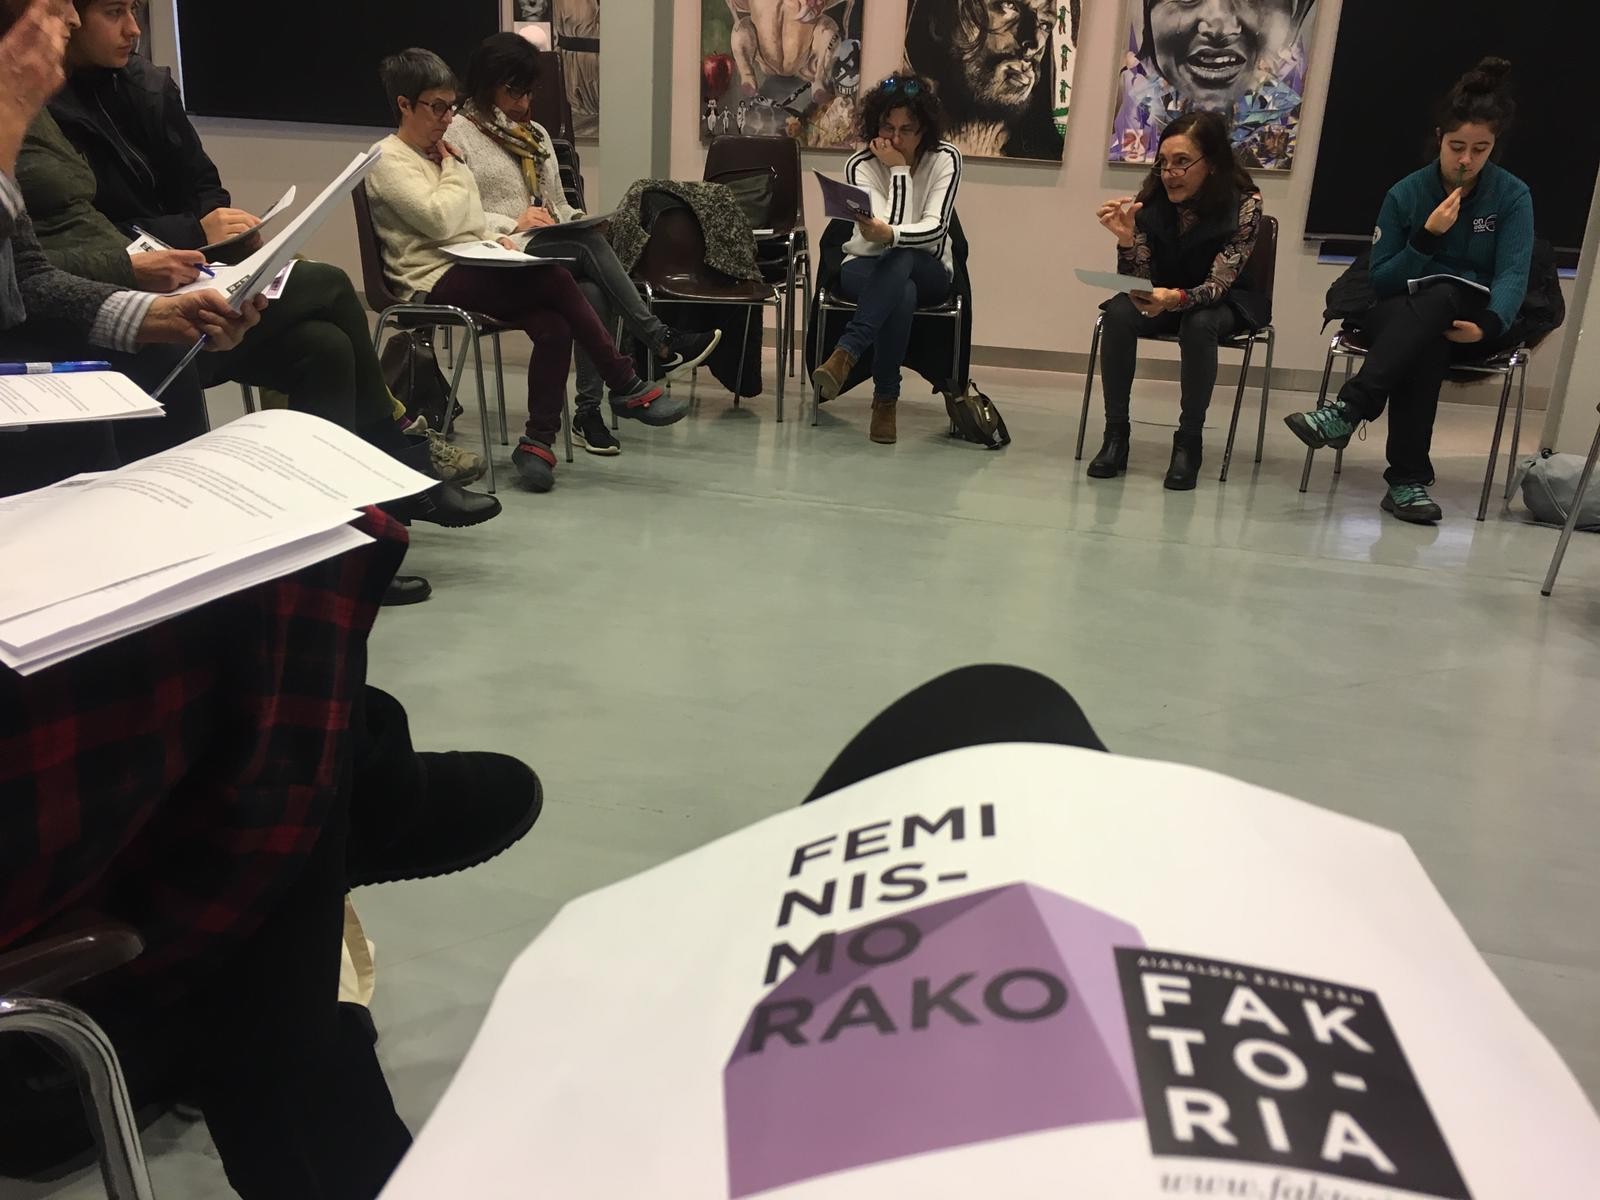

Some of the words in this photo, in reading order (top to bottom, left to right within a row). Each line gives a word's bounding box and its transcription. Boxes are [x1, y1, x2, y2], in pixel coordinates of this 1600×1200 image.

[788, 802, 996, 878] FEMI
[777, 861, 968, 927] NIS-
[763, 917, 923, 985] MO
[747, 967, 1069, 1054] RAKO
[1140, 971, 1375, 1054] FAK
[1164, 1086, 1398, 1175] RIA
